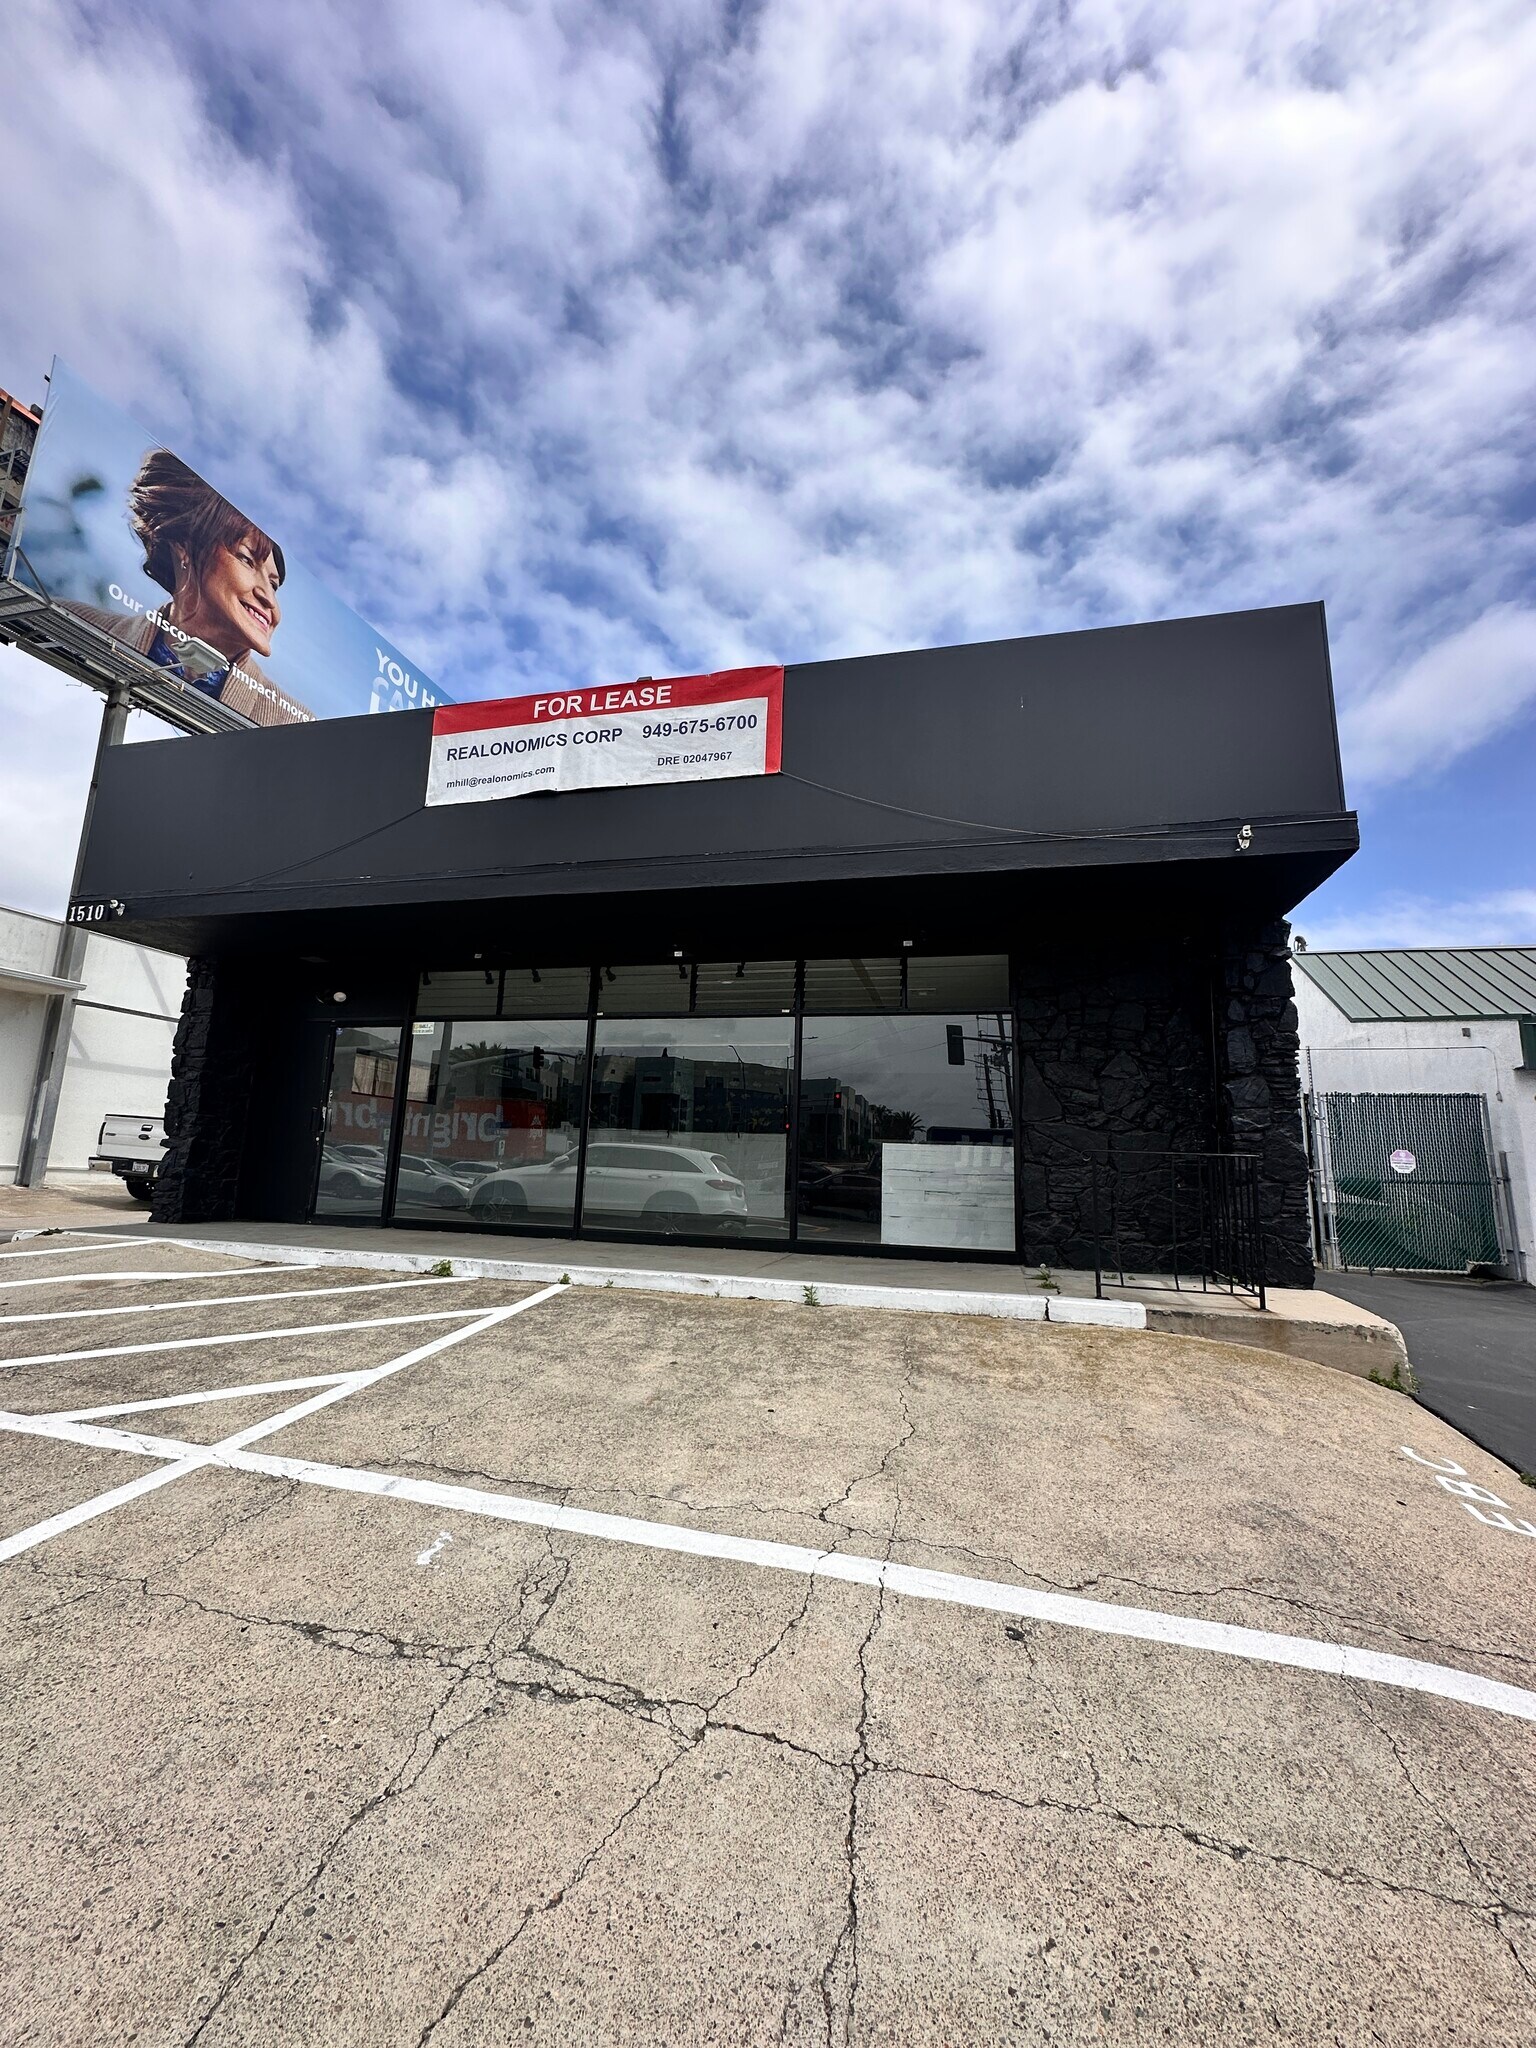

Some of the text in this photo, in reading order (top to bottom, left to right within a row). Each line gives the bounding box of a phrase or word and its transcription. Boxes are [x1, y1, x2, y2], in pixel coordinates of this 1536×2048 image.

[108, 583, 309, 722] Our discos impact more
[375, 647, 418, 698] YOU
[533, 685, 673, 718] FOR LEASE
[642, 714, 758, 739] 949-675-6700
[446, 728, 623, 761] REALONOMICS CORP
[657, 751, 733, 766] DRE 02047967
[446, 765, 555, 788] mhill@realonomics.com
[69, 904, 105, 922] 1510
